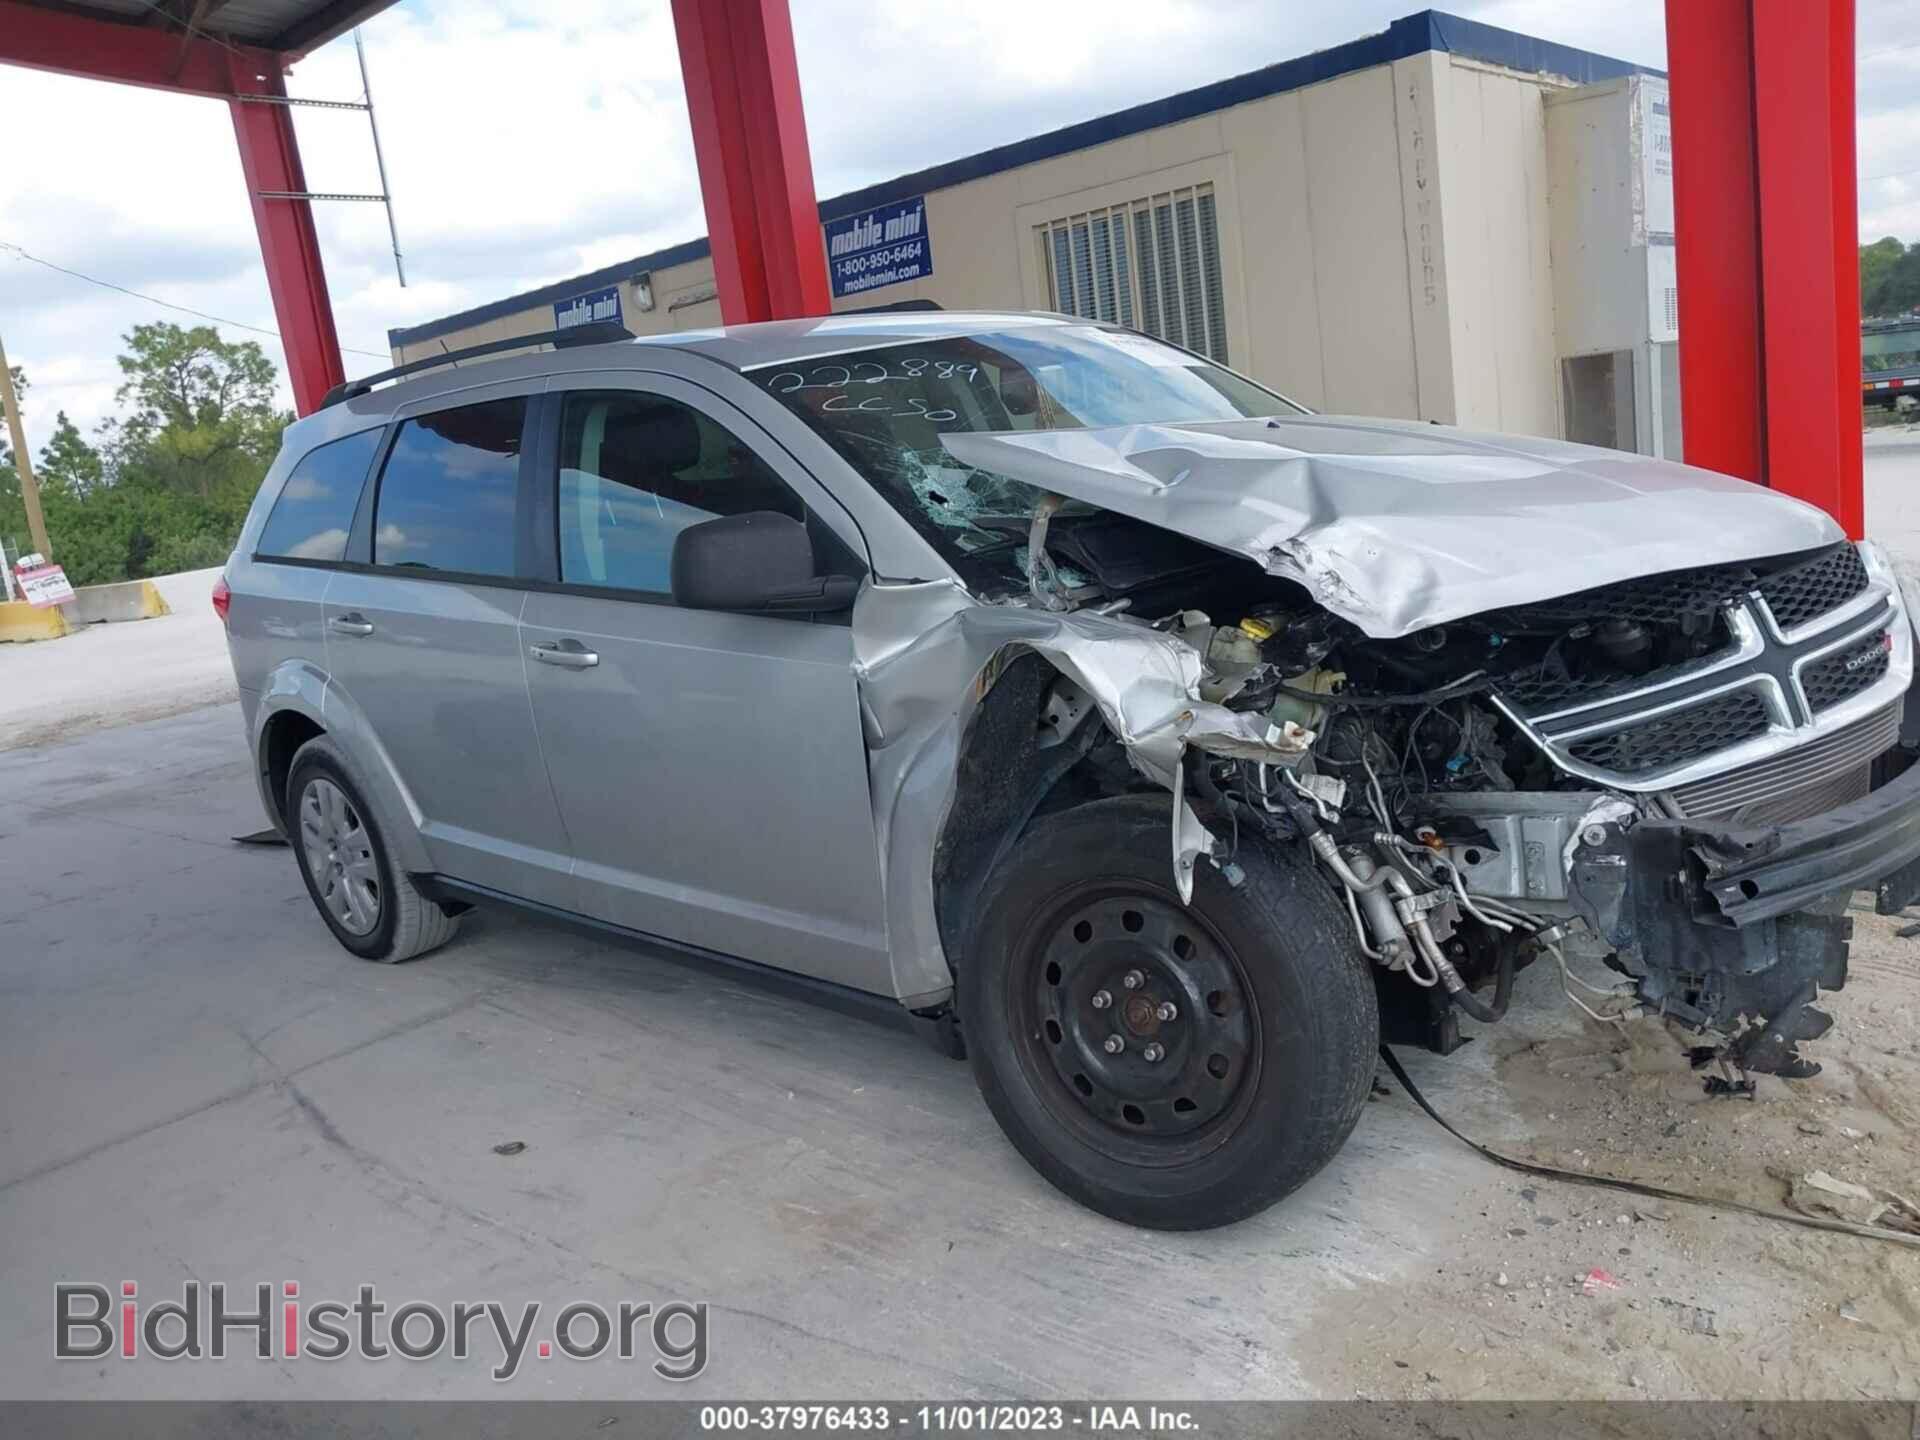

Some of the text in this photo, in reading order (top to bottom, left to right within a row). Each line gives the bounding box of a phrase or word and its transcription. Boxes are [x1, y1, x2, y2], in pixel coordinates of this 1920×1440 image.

[831, 205, 922, 257] mobile mini
[836, 242, 922, 278] 1-800-950-6464
[843, 264, 920, 293] mobilemini.com
[593, 292, 618, 320] mini
